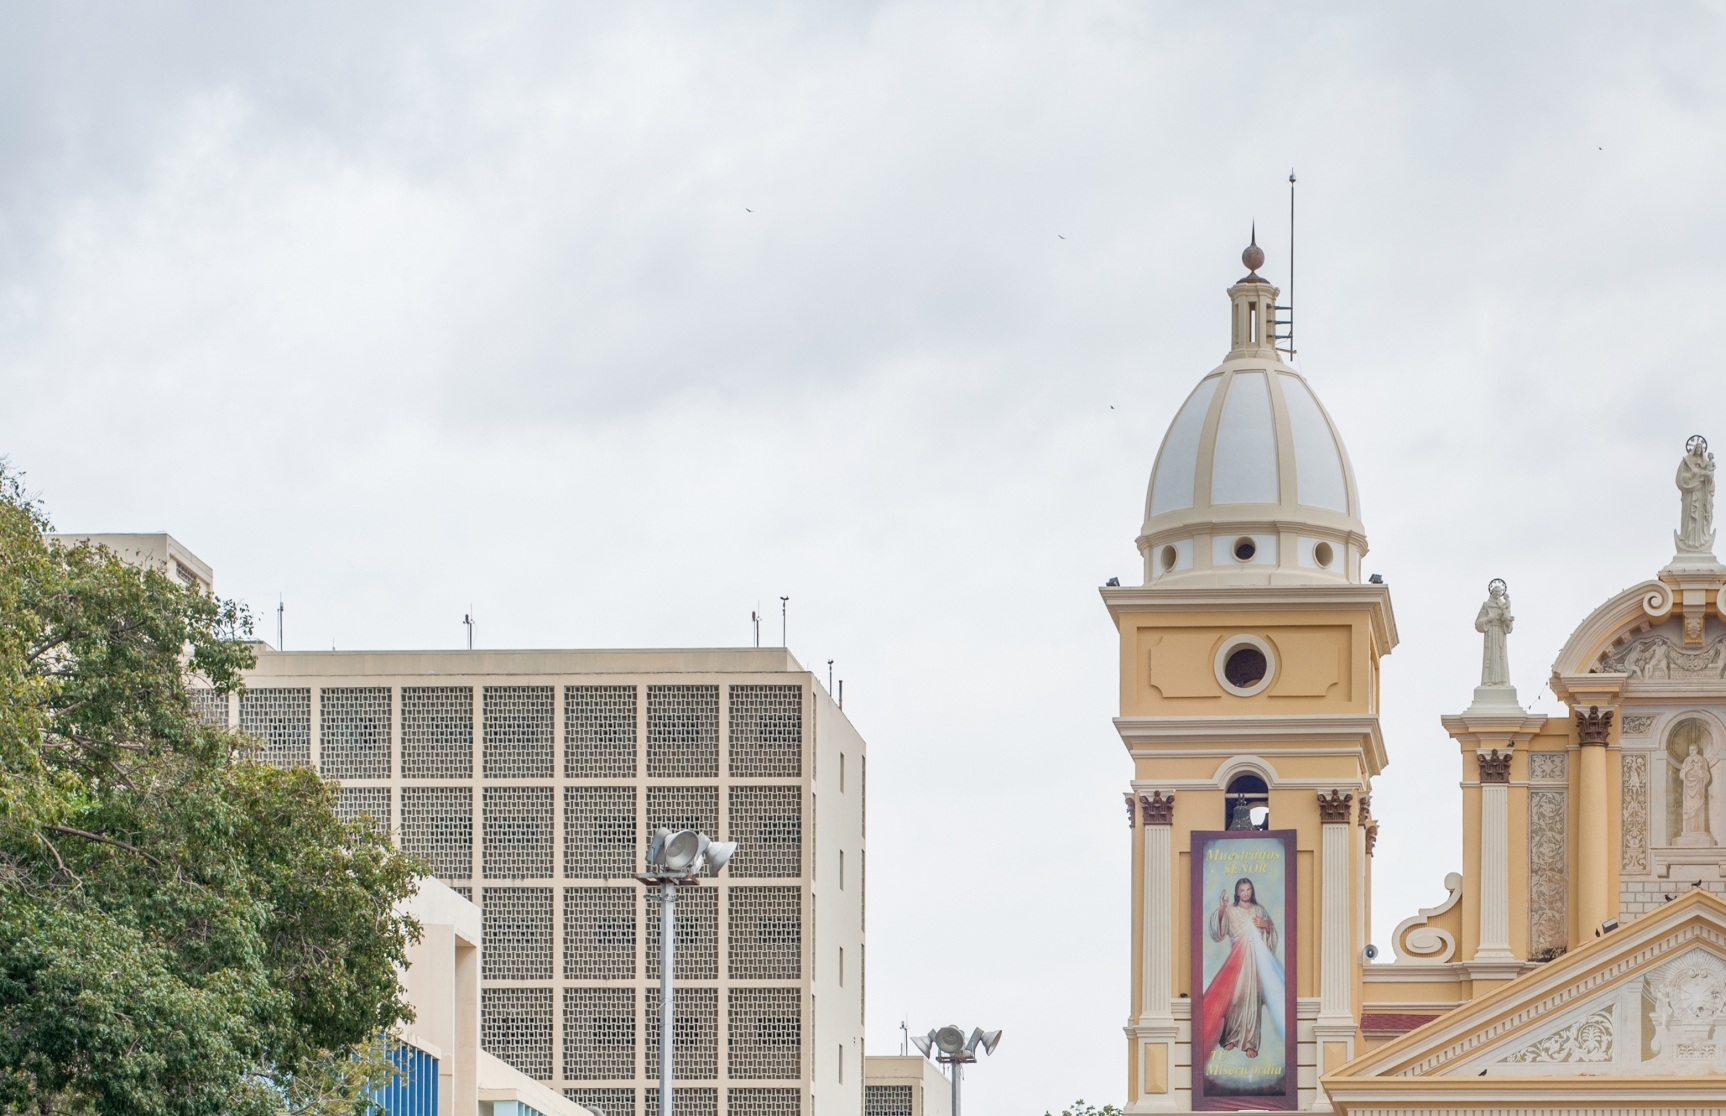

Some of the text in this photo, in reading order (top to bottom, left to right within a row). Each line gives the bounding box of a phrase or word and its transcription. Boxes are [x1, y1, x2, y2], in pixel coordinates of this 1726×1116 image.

[1206, 849, 1280, 861] Muéstranos
[1223, 861, 1267, 875] SEÑOR
[1206, 1064, 1282, 1076] Misericordia
